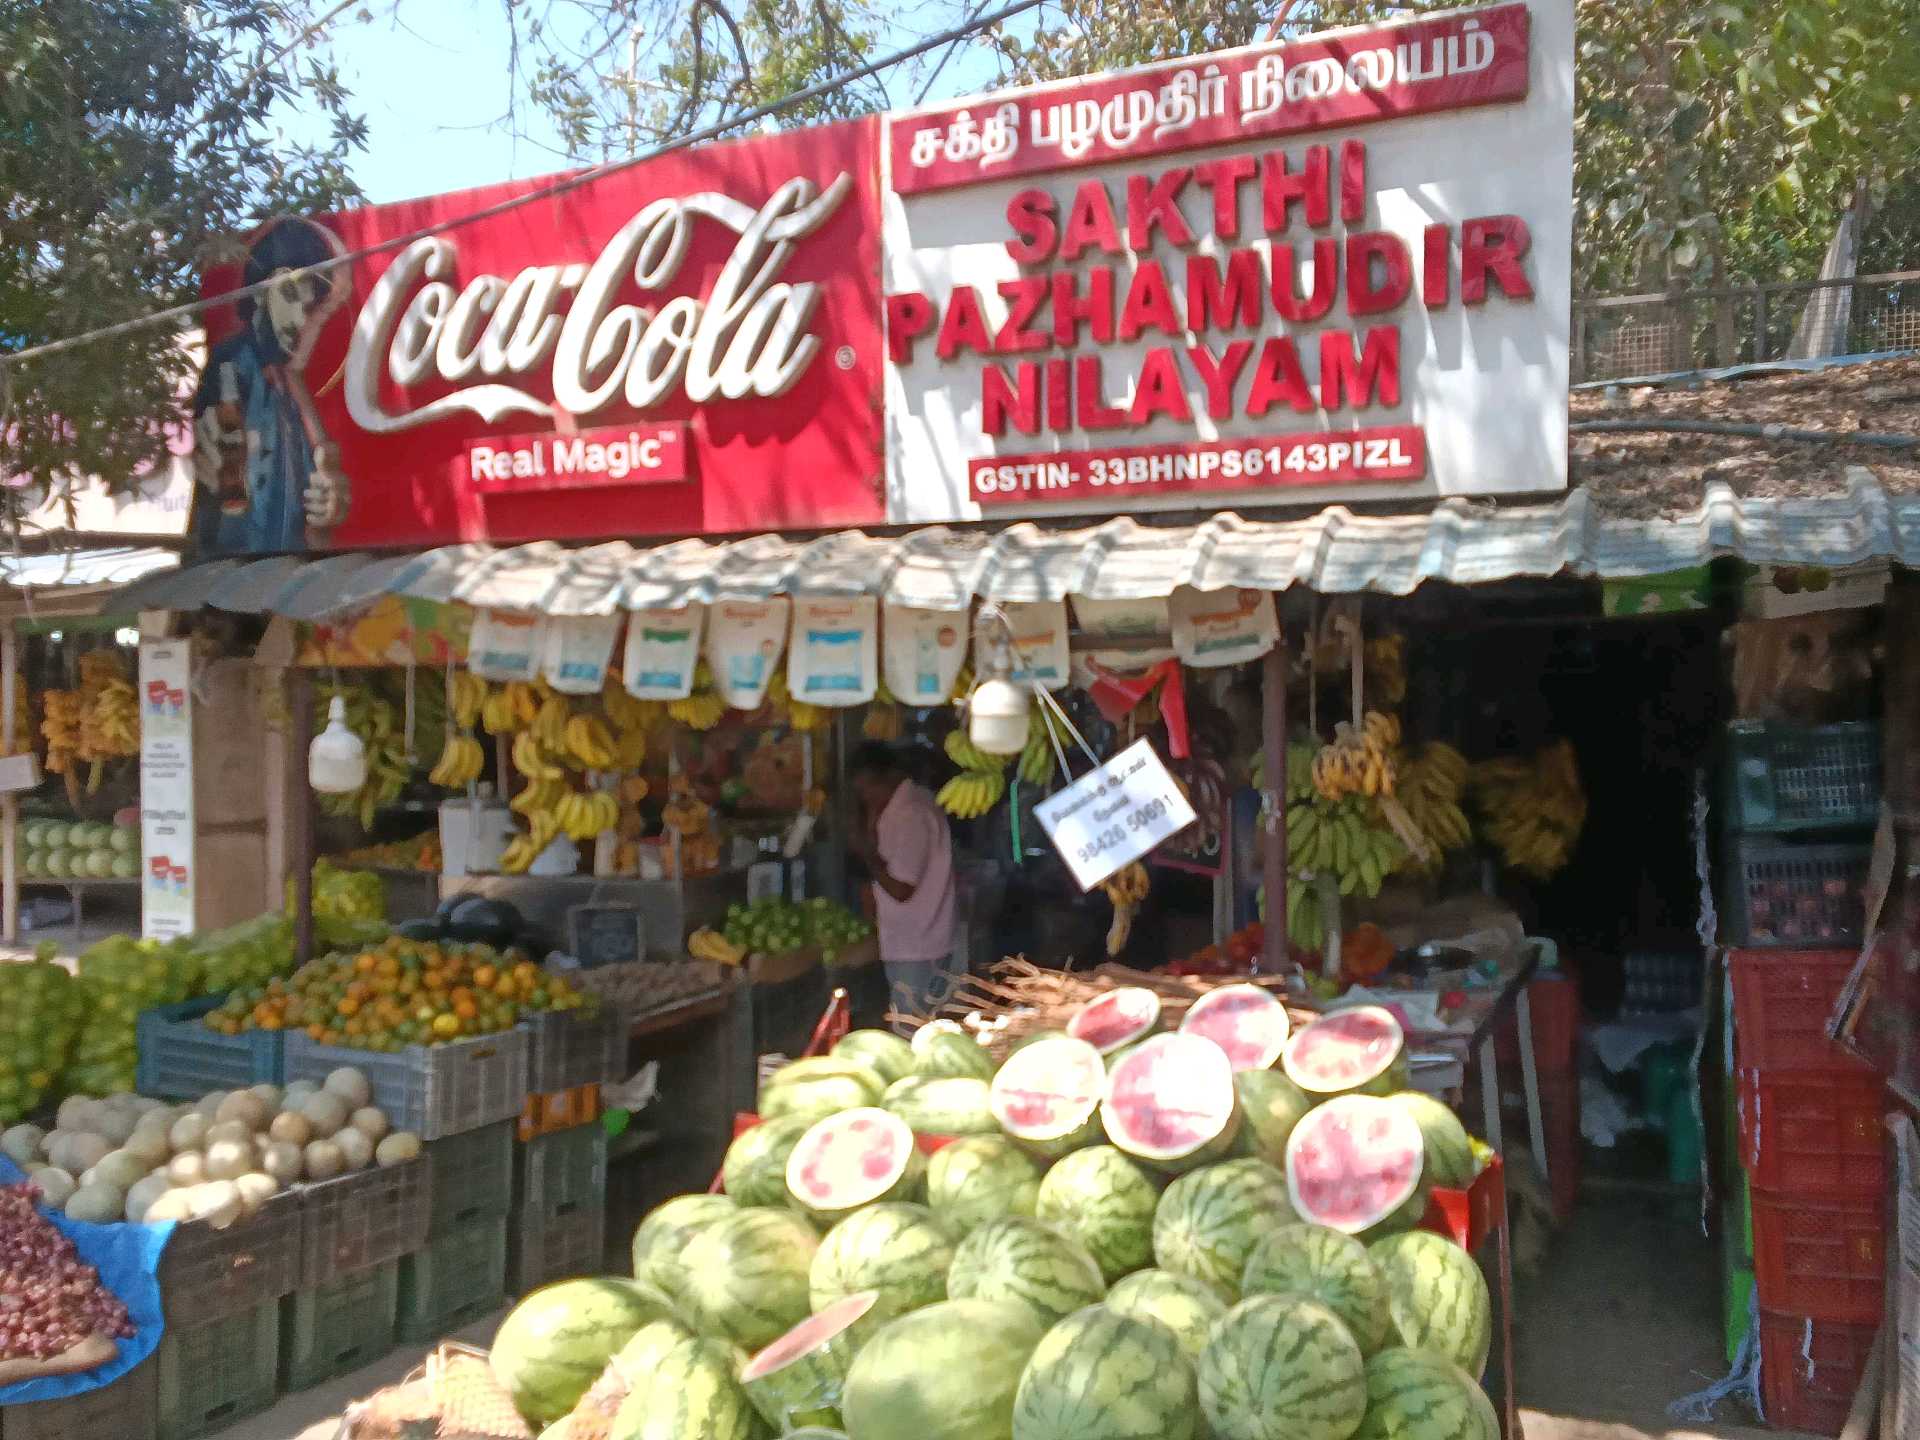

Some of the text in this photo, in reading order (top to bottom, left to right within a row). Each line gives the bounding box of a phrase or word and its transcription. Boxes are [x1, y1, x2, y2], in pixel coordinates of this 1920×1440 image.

[910, 19, 1495, 170] சக்தி பழமுதிர் நிலையம்
[1006, 139, 1366, 264] SAKTHI
[344, 171, 853, 432] Coca-Cola
[887, 214, 1534, 364] PAZHAMUDIR
[981, 325, 1403, 437] NILAYAM
[471, 440, 545, 481] Real
[975, 462, 1080, 494] GSTIN-
